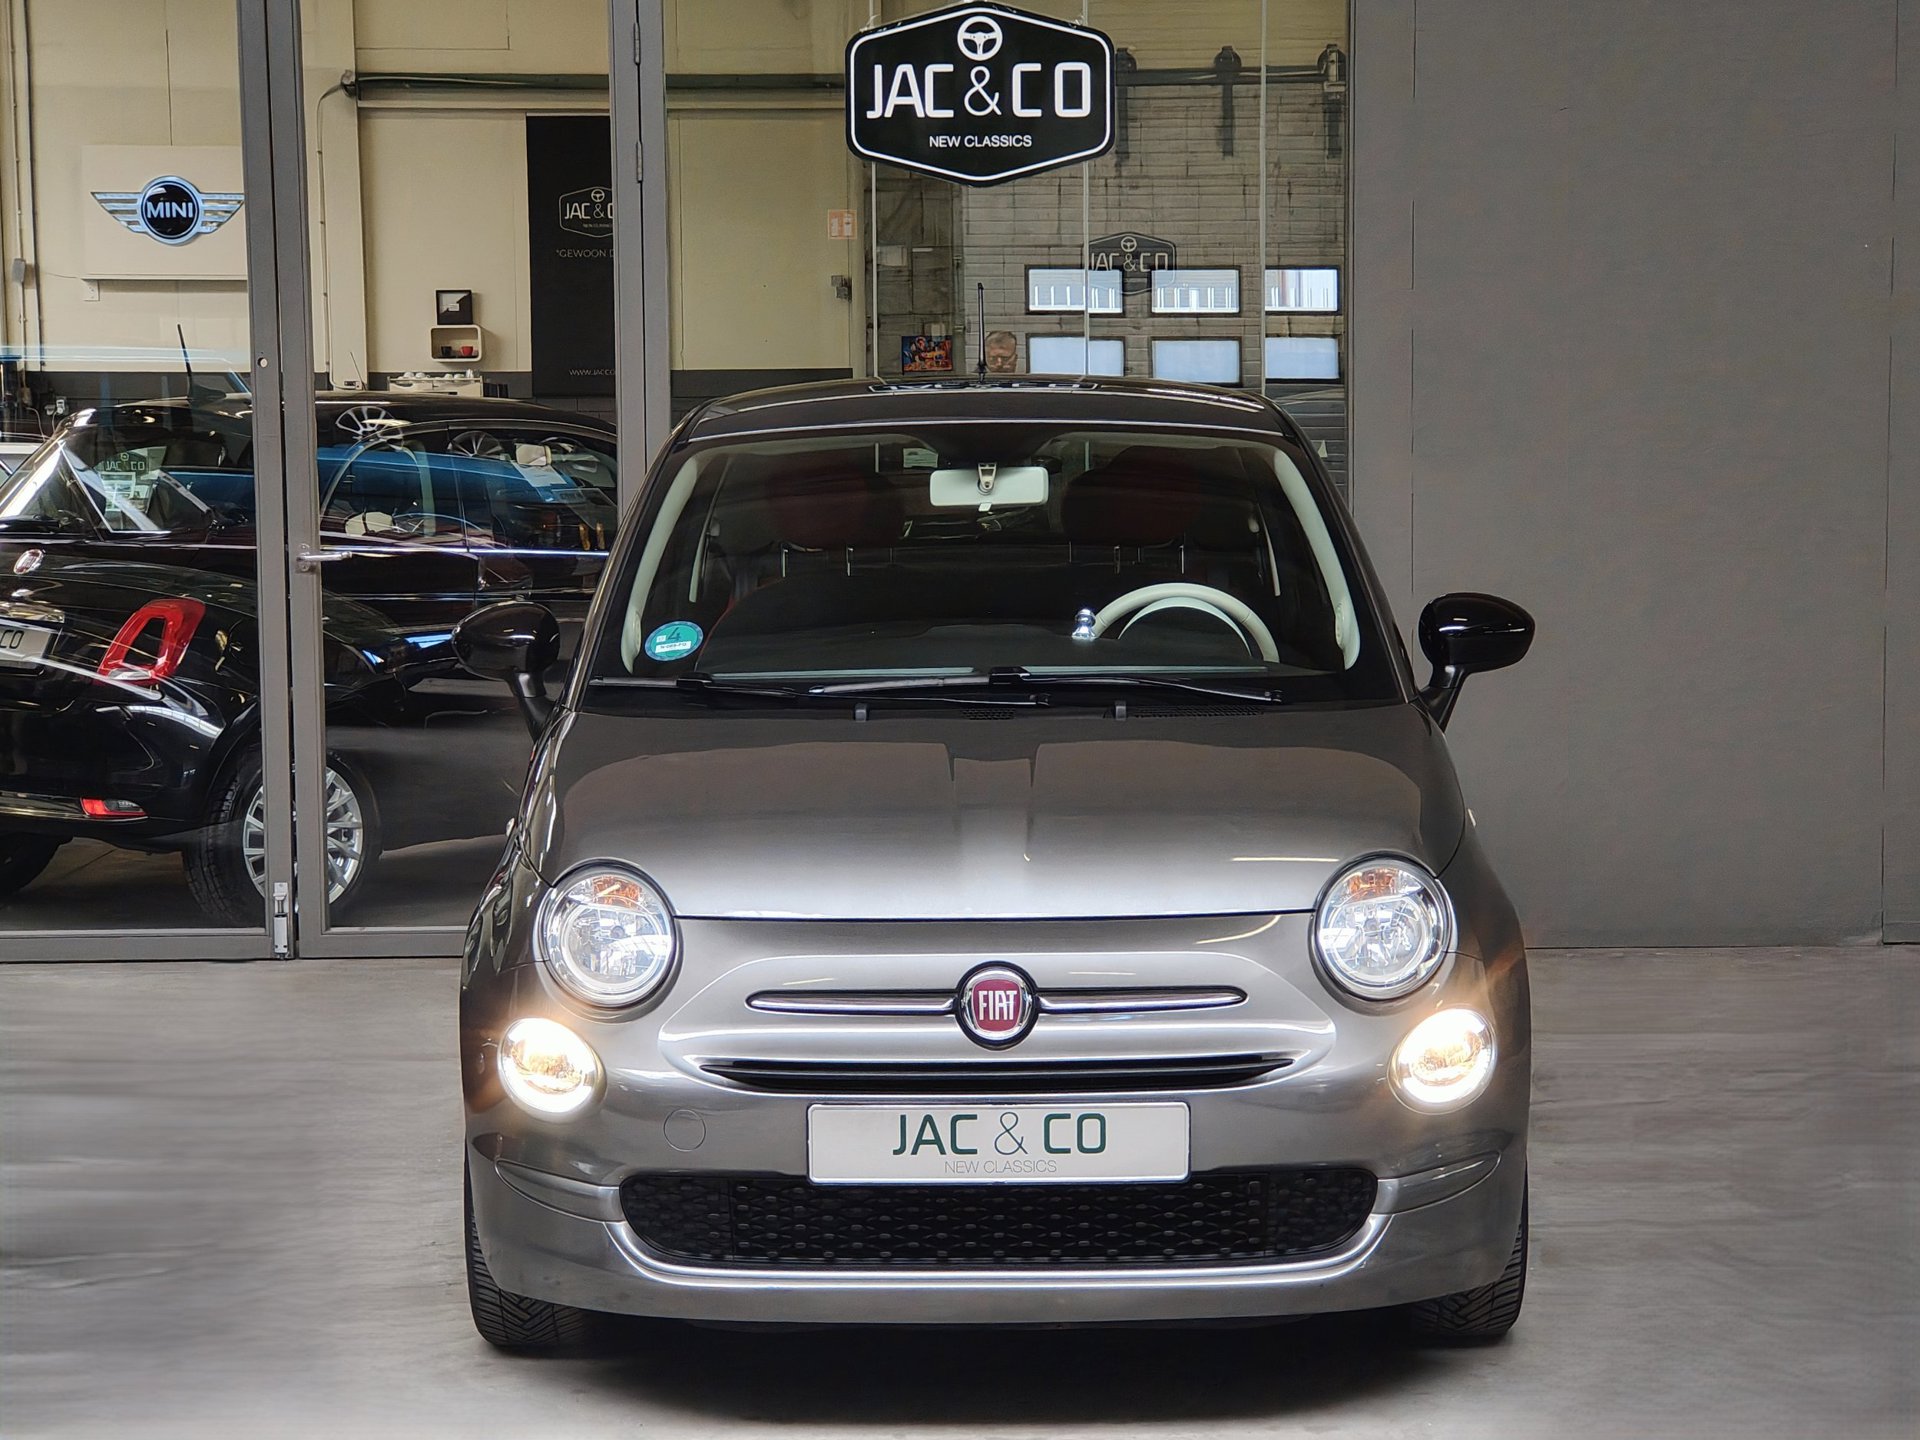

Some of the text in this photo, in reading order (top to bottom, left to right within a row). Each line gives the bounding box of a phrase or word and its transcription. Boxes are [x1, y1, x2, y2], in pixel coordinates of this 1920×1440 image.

[866, 61, 1091, 119] JAC & CO
[929, 134, 1033, 148] NEW CLASSICS
[146, 201, 194, 218] MINI
[564, 202, 614, 219] JAC & C
[978, 990, 1018, 1021] FIAT
[892, 1111, 1107, 1156] JAC & CO
[944, 1159, 1057, 1174] NEW CLASSICS
